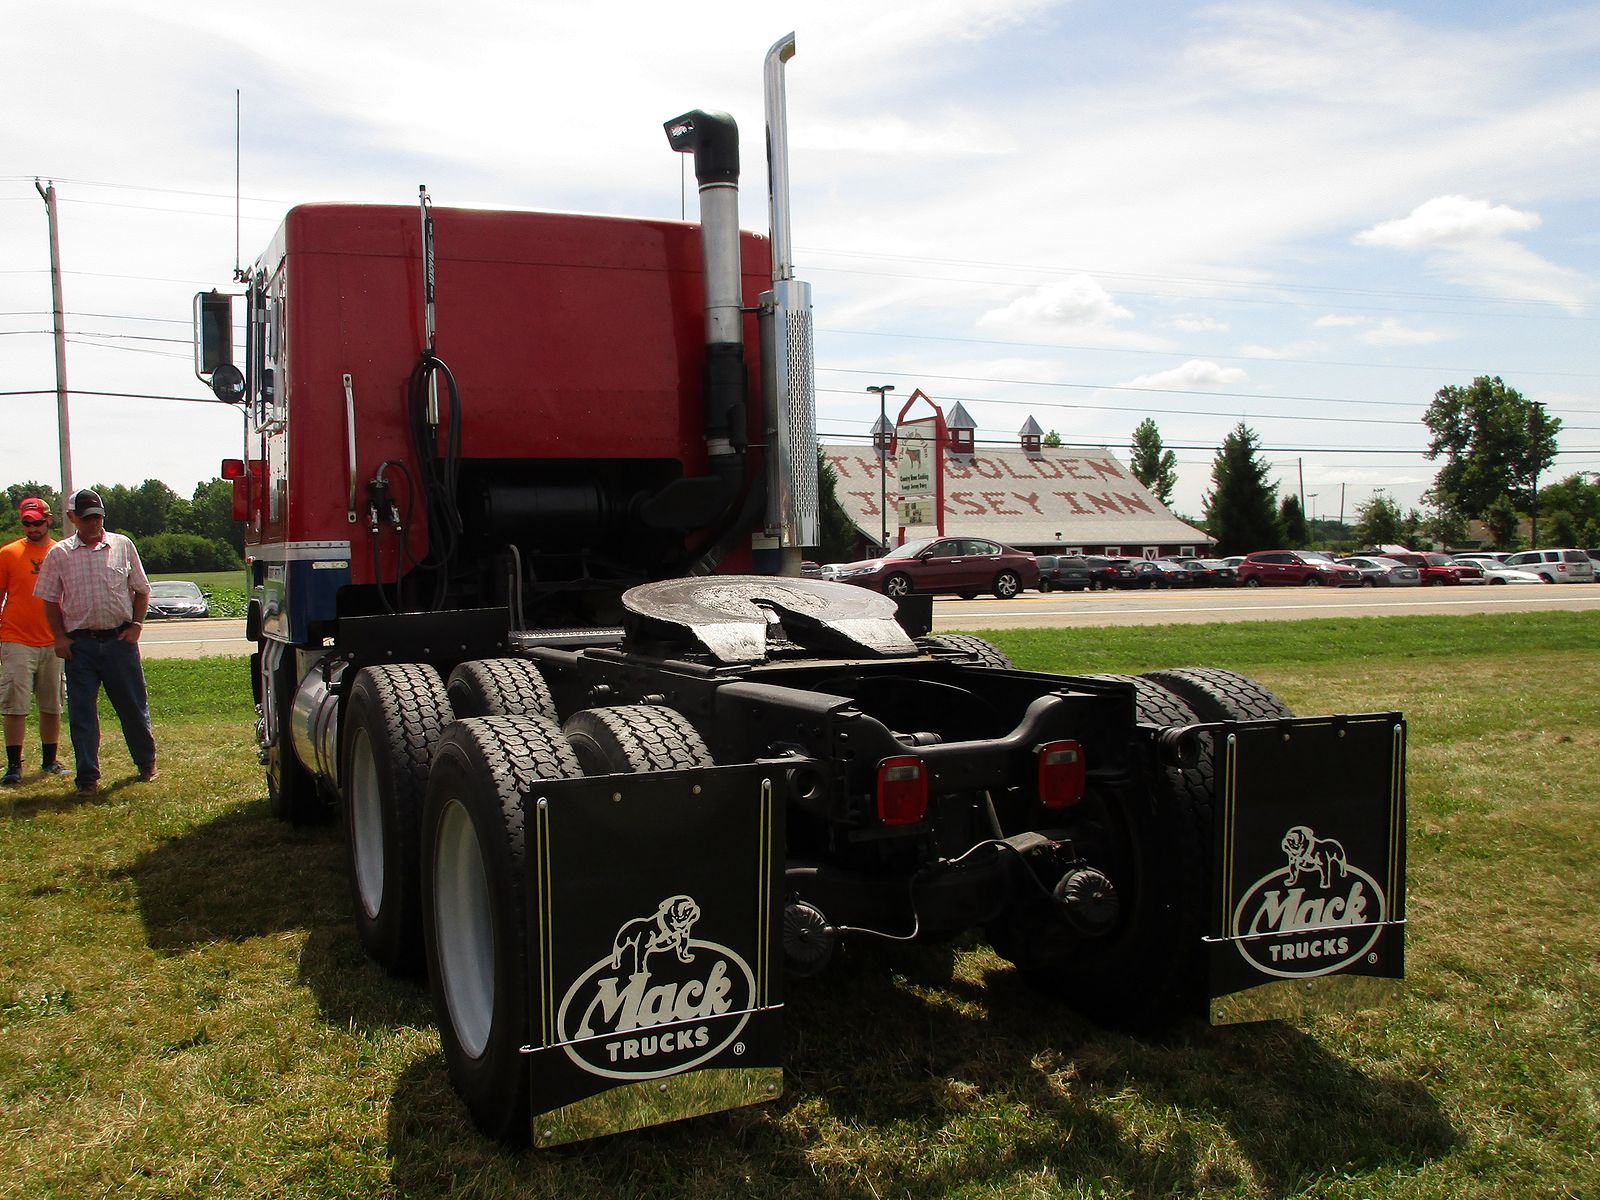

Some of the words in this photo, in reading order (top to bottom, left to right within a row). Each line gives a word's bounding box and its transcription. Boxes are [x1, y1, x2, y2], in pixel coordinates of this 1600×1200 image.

[824, 456, 898, 478] TH
[943, 457, 1126, 480] GOLDEN
[848, 491, 1044, 515] JSEY
[1052, 492, 1155, 514] INN
[1246, 881, 1367, 941] Mack
[1269, 937, 1349, 962] TRUCKS
[574, 960, 732, 1039] Mack
[606, 1026, 710, 1062] TRUCKS
